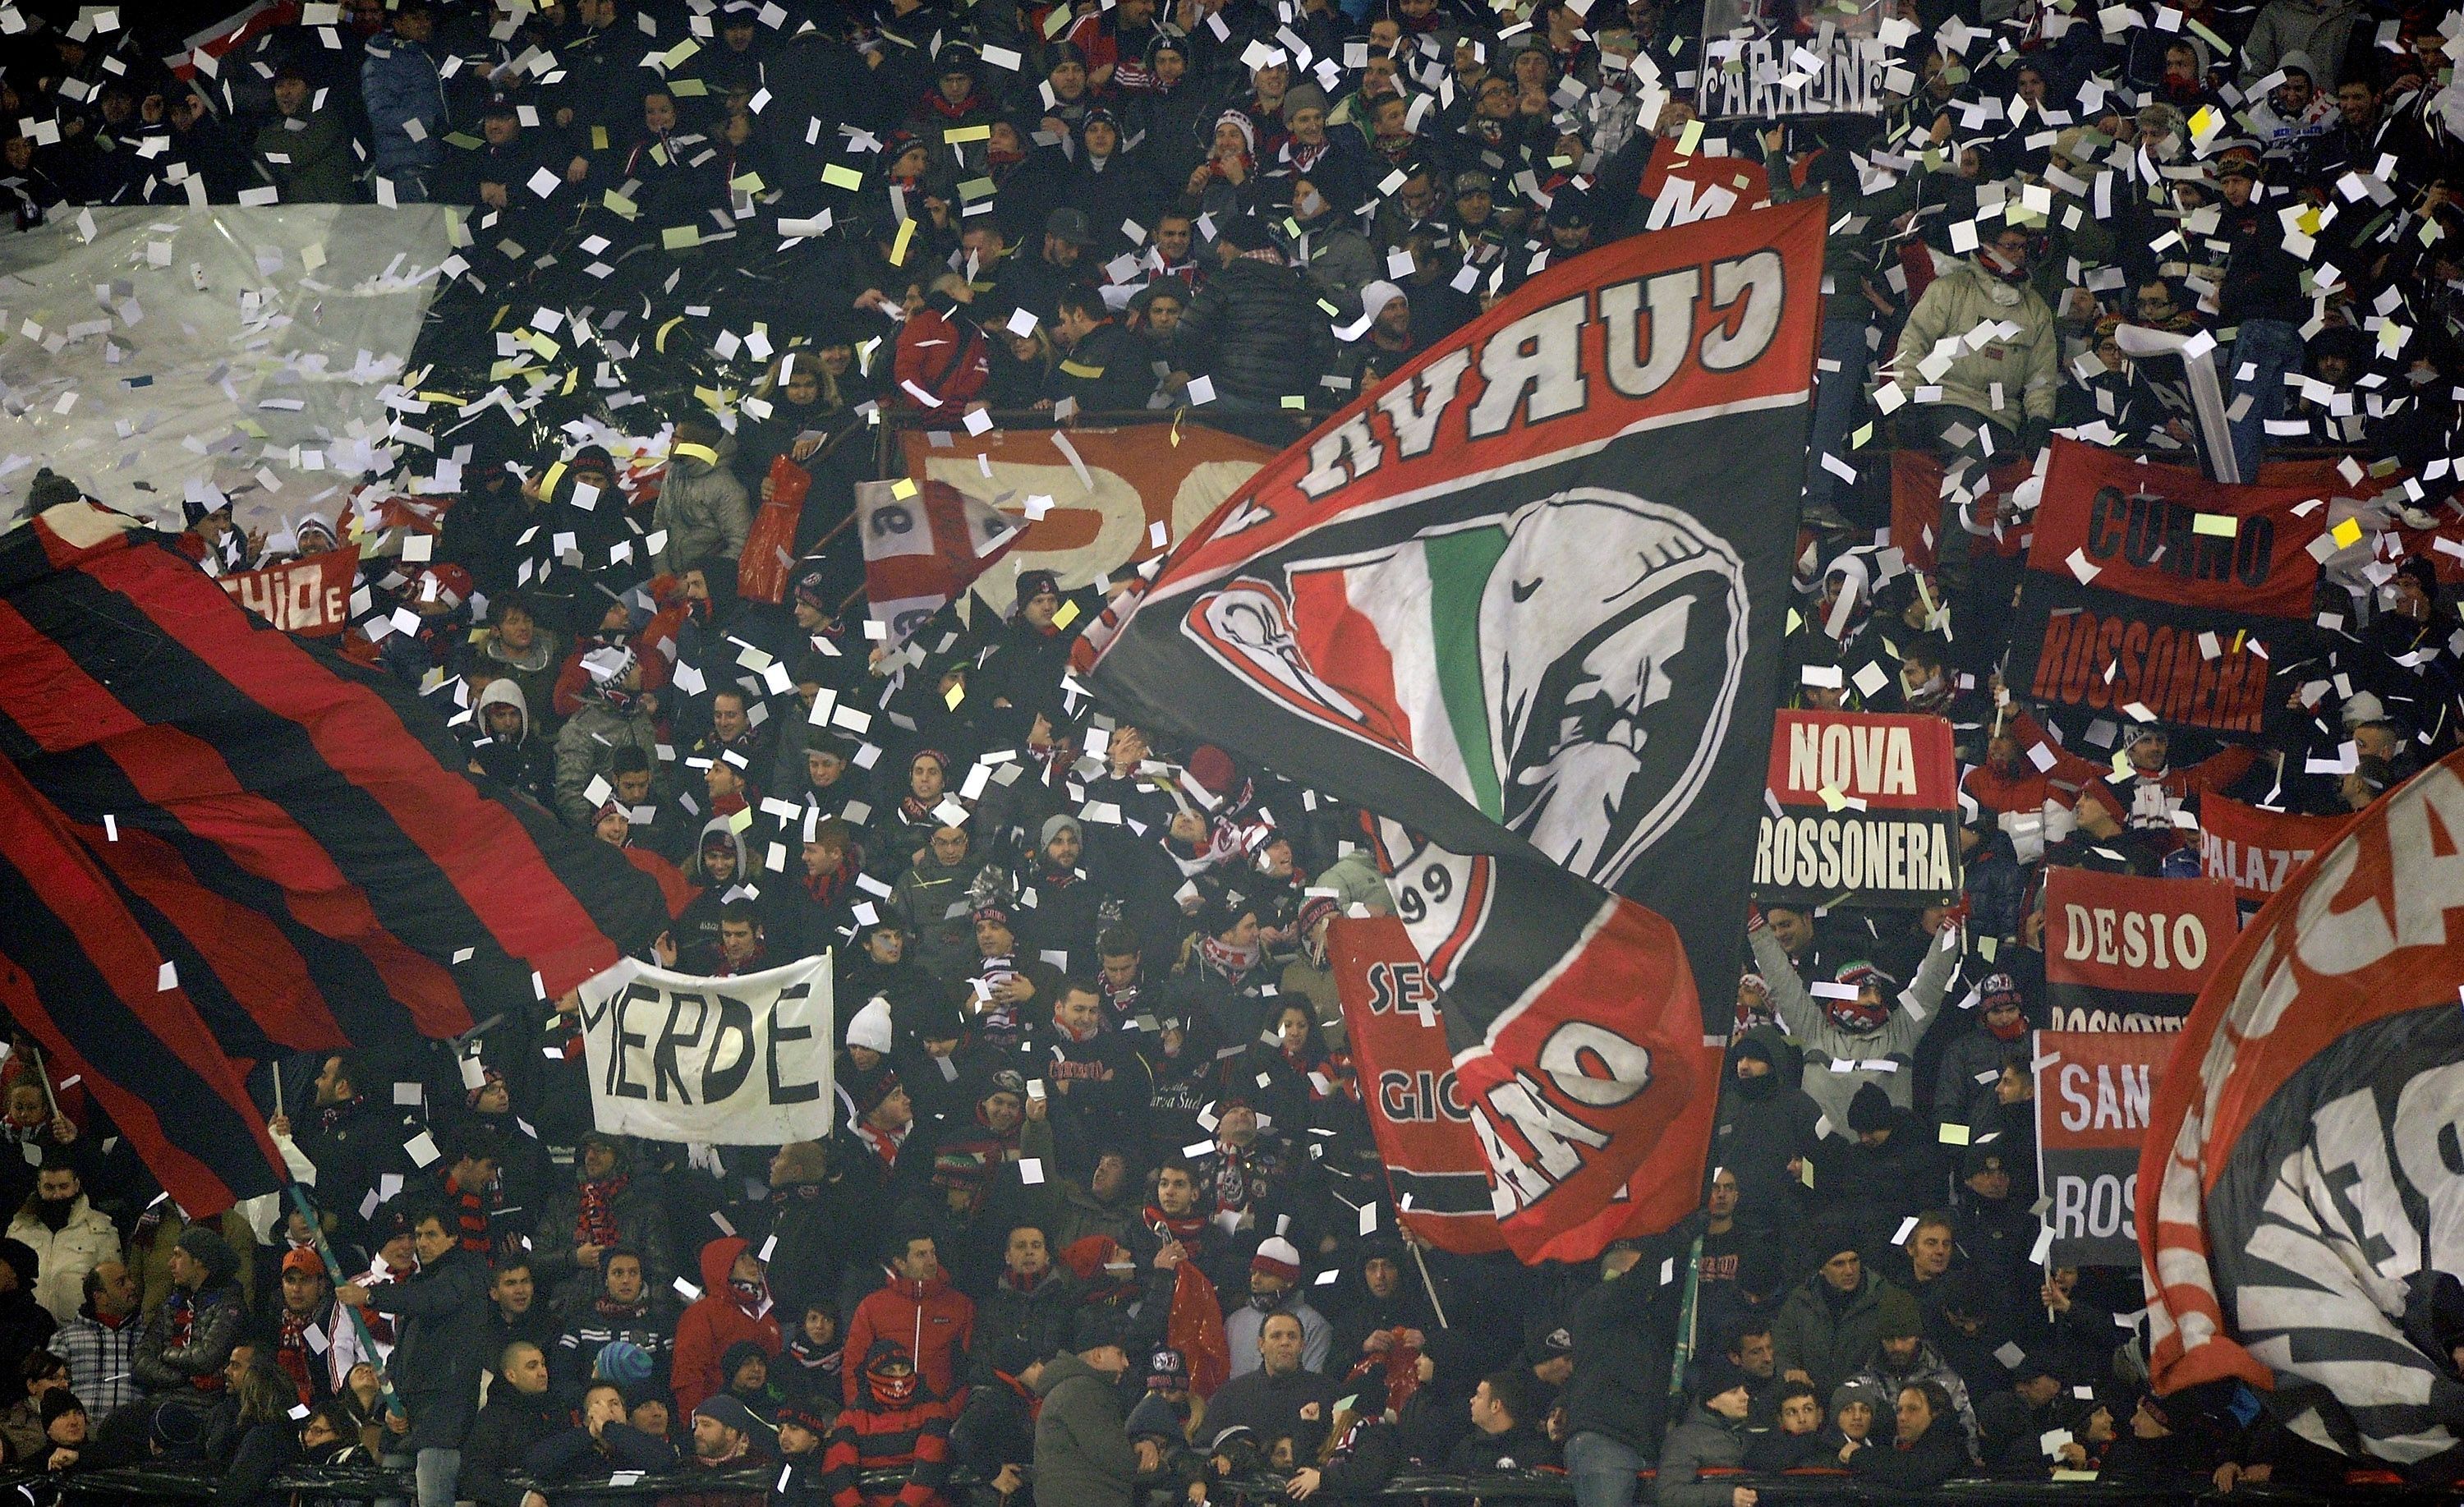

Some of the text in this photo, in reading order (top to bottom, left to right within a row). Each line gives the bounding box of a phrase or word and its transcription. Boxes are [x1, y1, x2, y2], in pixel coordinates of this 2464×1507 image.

[2031, 611, 2270, 733] ROSSONERA
[1788, 723, 1917, 795] NOVA
[1753, 816, 1953, 890] ROSSONERA
[2064, 903, 2208, 971] DESIO
[2060, 1063, 2150, 1132] SAN
